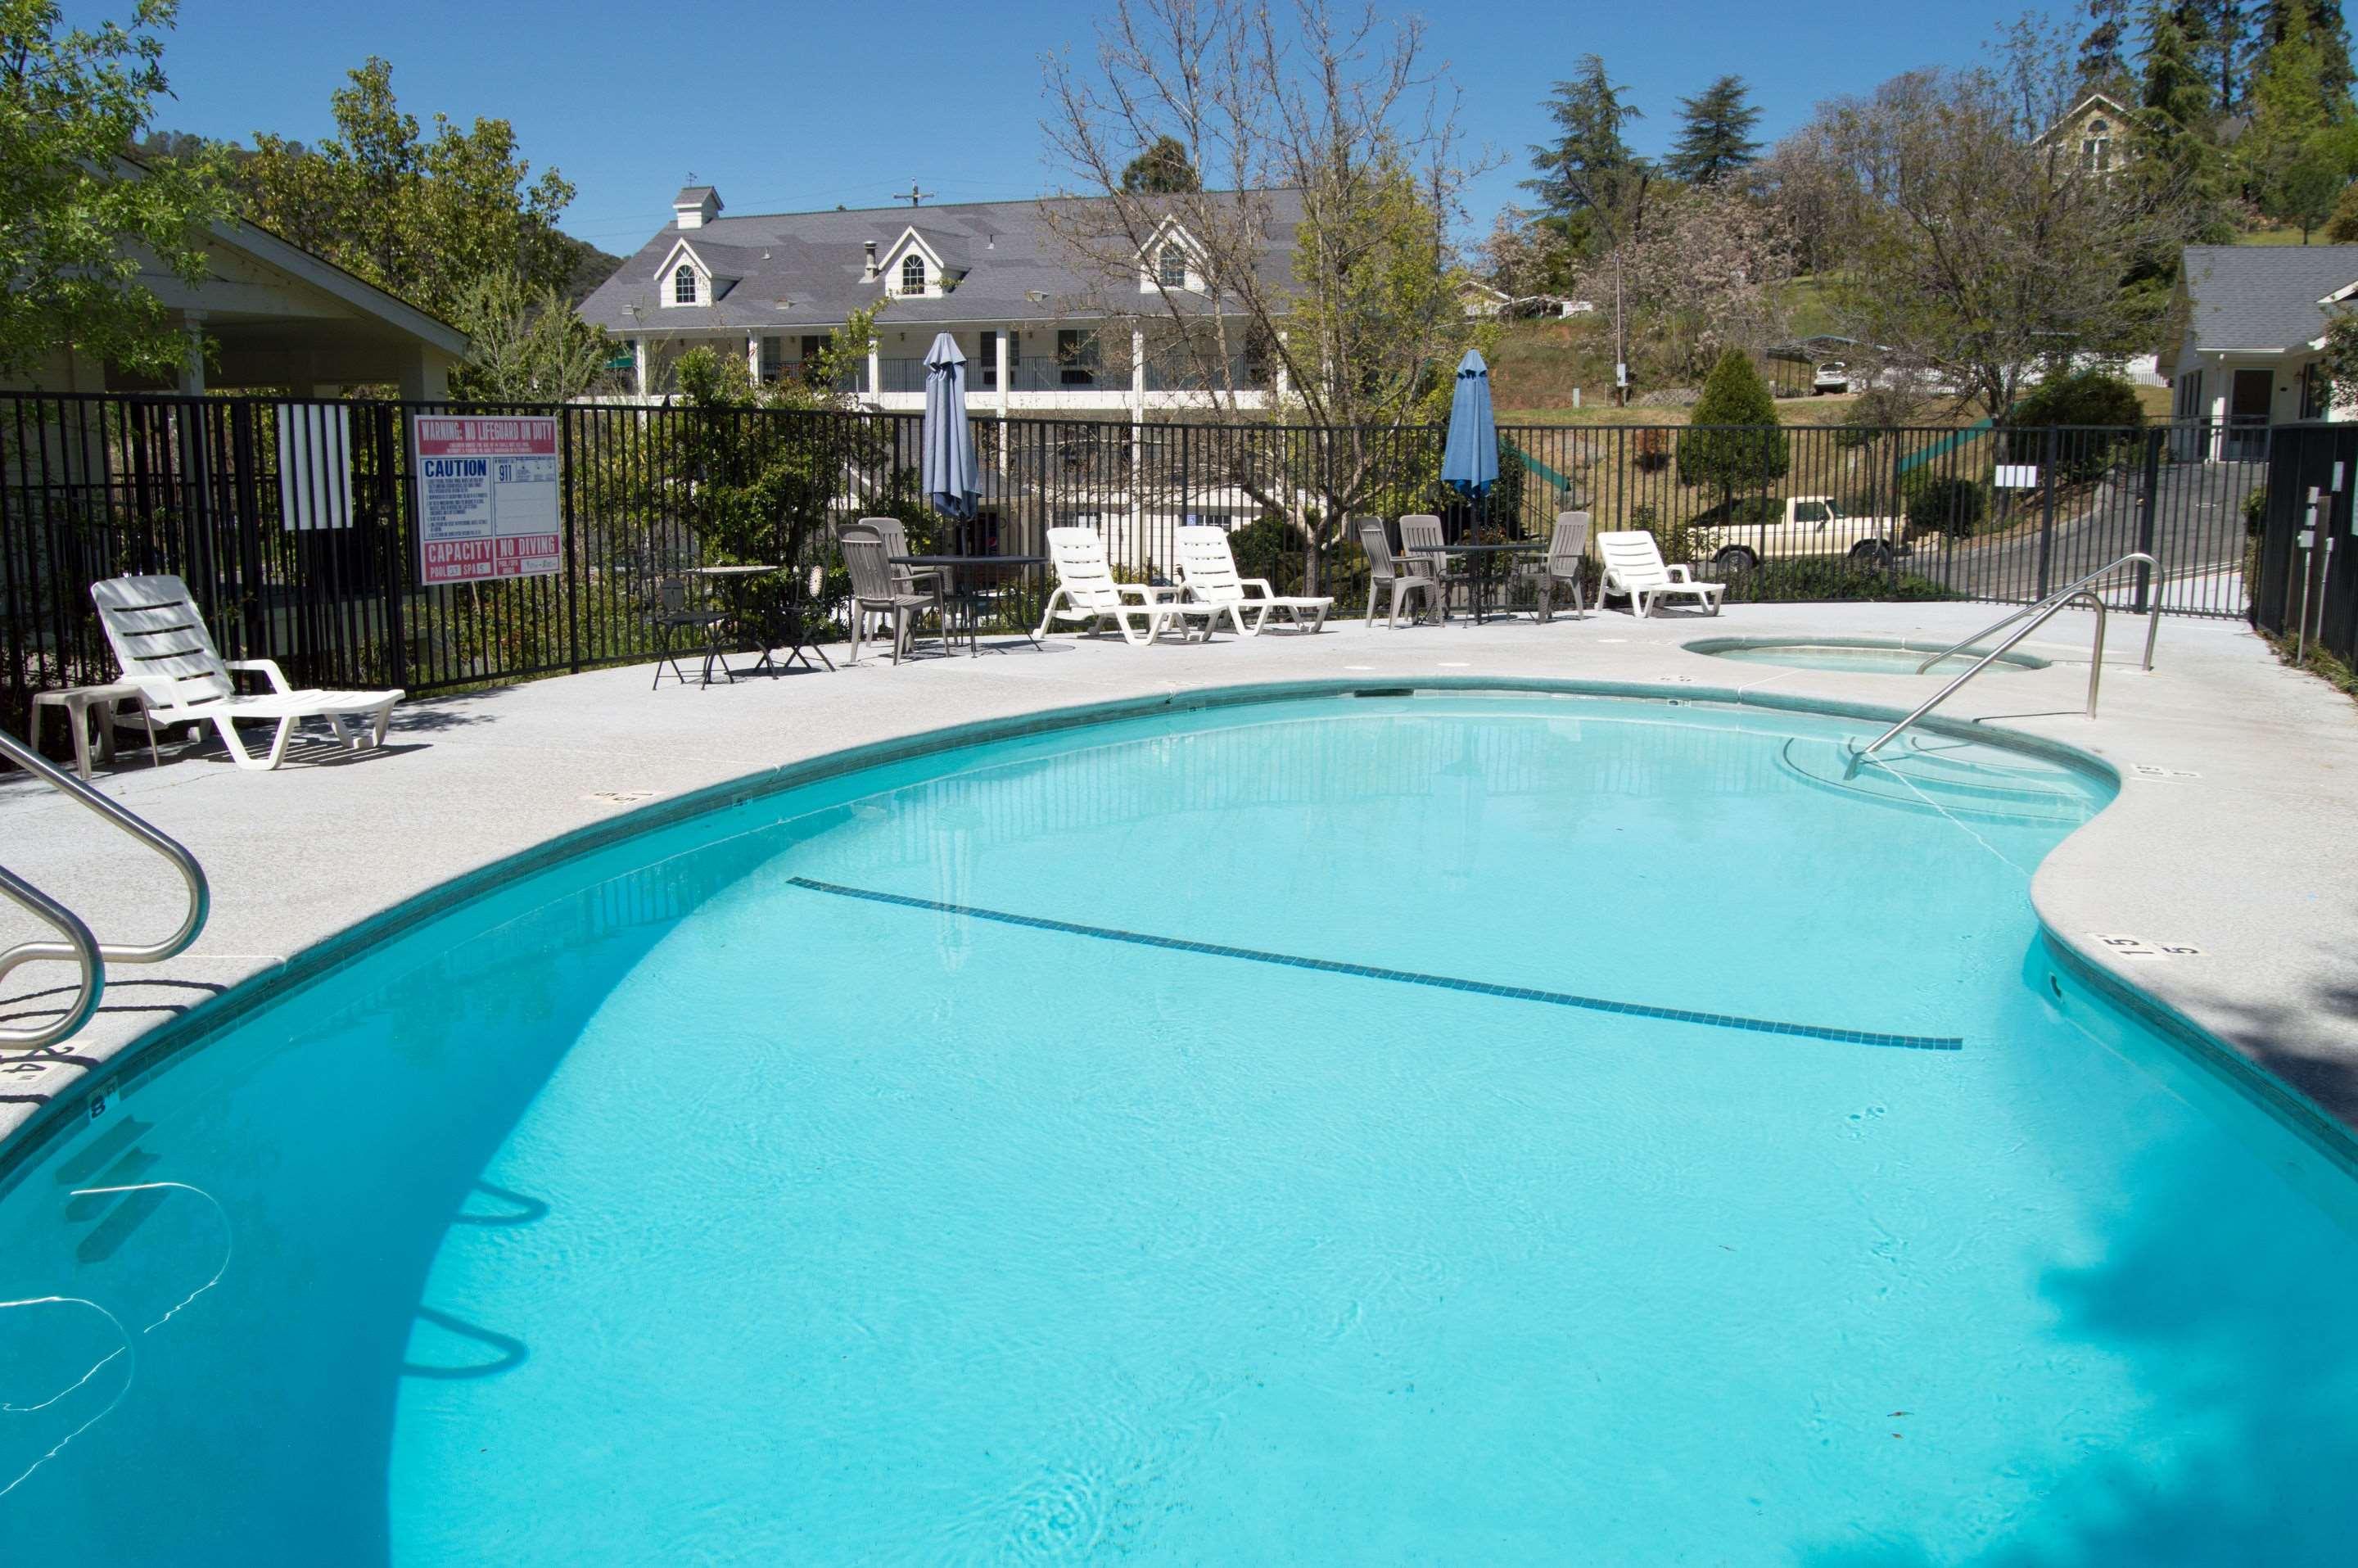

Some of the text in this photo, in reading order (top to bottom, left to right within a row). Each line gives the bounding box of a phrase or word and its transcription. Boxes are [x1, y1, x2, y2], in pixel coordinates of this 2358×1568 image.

[422, 422, 552, 441] WARNING: NO LIFEGUARD ON DUTY
[425, 459, 487, 477] CAUTION
[499, 464, 512, 481] 911
[428, 540, 490, 563] CAPACITY
[499, 536, 555, 558] NO DIVING
[430, 564, 447, 578] POOL
[463, 563, 477, 576] SPA
